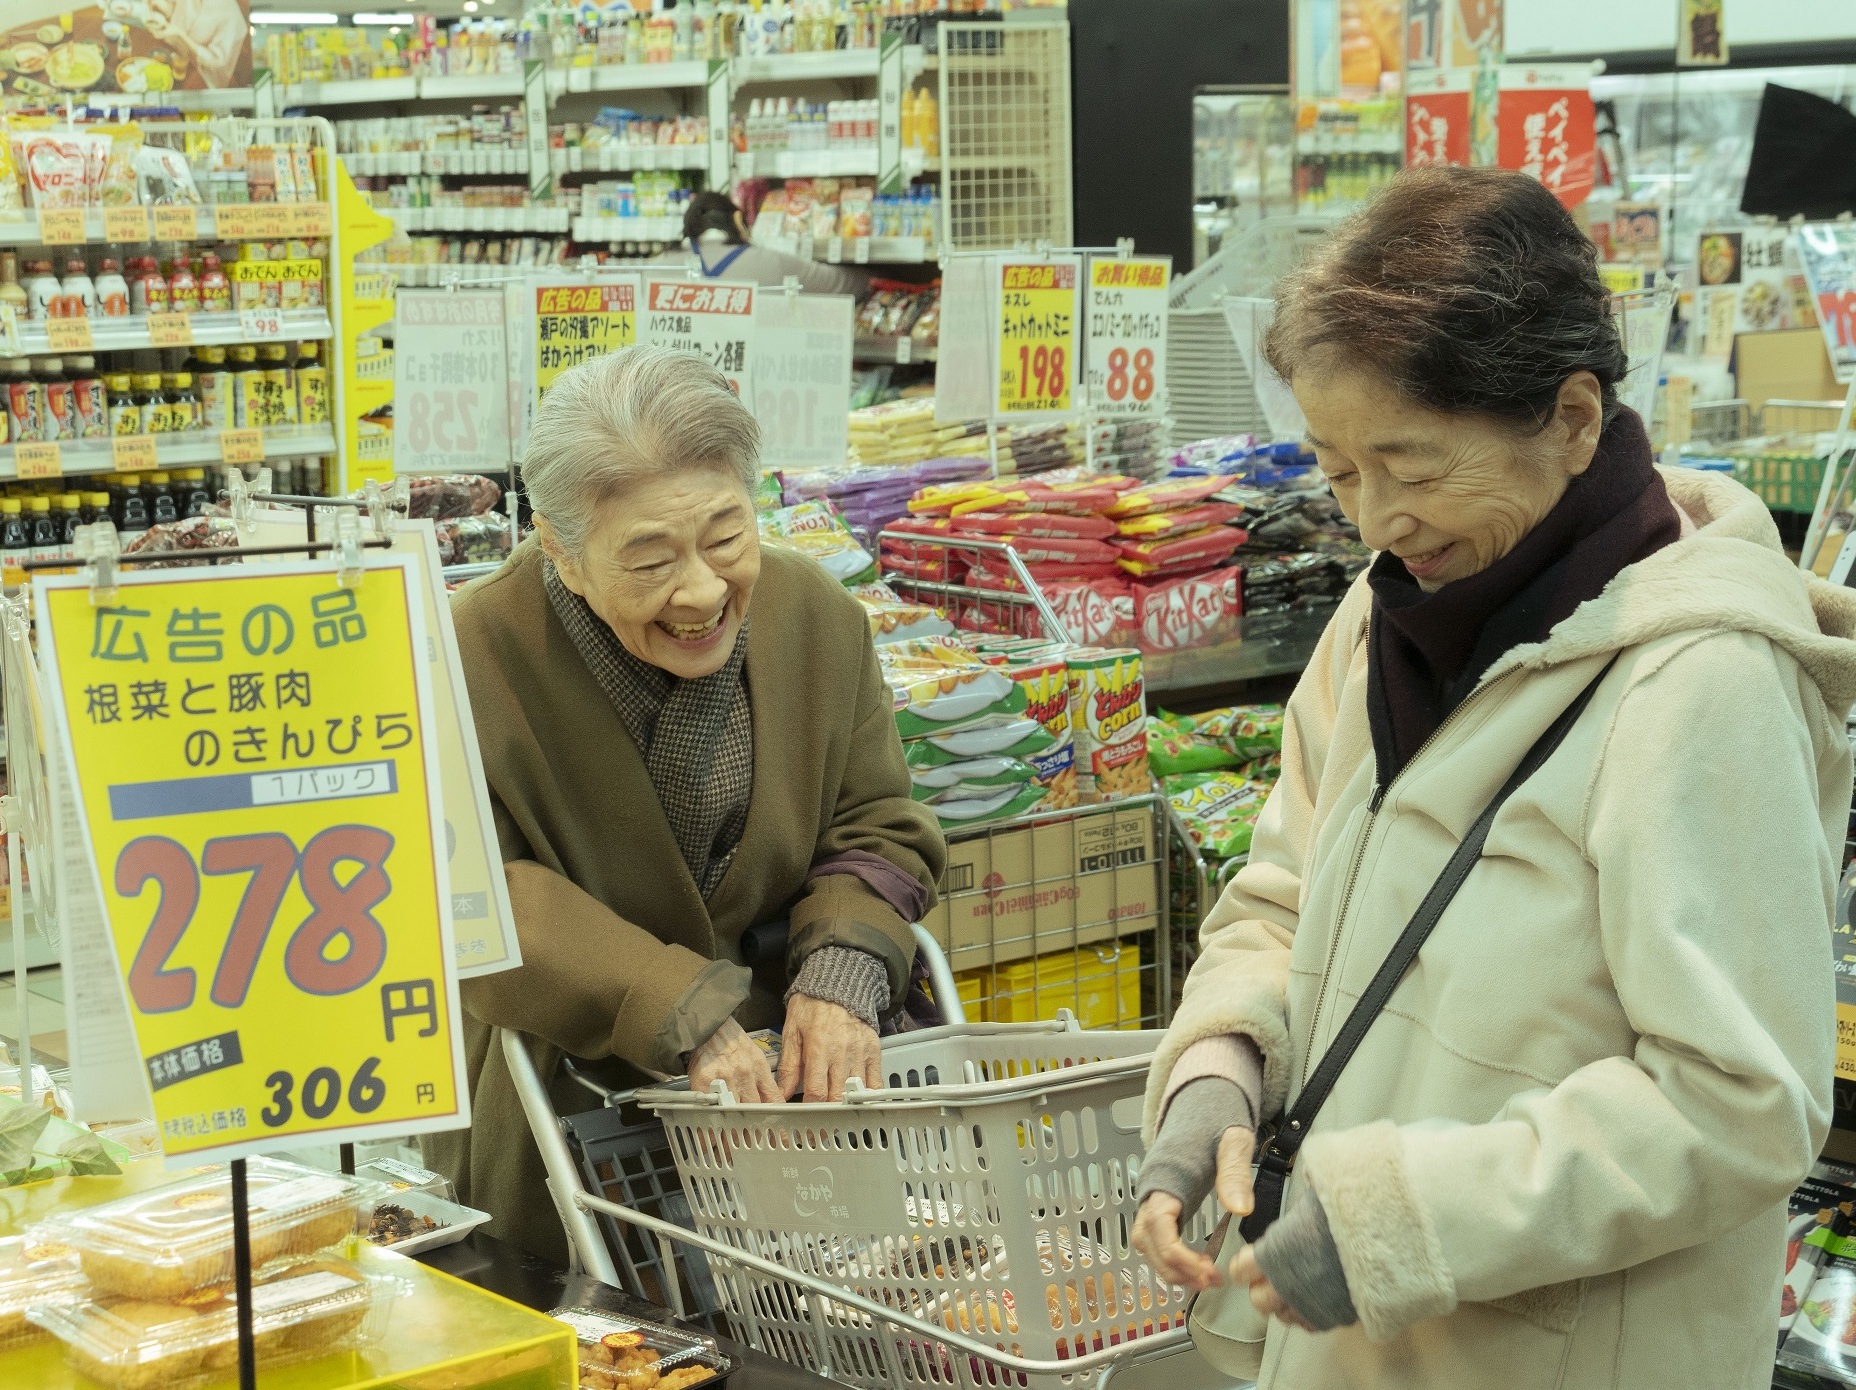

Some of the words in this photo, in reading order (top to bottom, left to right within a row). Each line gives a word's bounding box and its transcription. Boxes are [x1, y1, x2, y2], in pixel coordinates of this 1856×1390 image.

[1547, 97, 1569, 189] ペイペイ
[240, 264, 278, 279] おでん
[282, 262, 320, 279] おでん
[1004, 266, 1056, 288] 広告の品
[539, 287, 602, 312] 広告の品
[655, 285, 749, 314] 更にお買得
[1004, 292, 1031, 307] ネスレ
[1095, 291, 1123, 306] でん六
[255, 319, 279, 334] 98
[650, 315, 692, 333] ハウス食品
[1004, 312, 1070, 339] キットカットミニ
[1019, 344, 1066, 400] 198
[1107, 347, 1155, 402] 88
[90, 588, 368, 665] 広告の品
[1154, 583, 1221, 649] KitKat
[84, 669, 313, 725] 根菜と豚肉
[1094, 680, 1143, 722] とんがり
[1099, 702, 1142, 741] Corn
[184, 712, 414, 768] のきんぴら
[269, 766, 377, 800] 1パック
[114, 824, 396, 1016] 278
[380, 979, 441, 1042] 円
[150, 1039, 224, 1083] 本体価格
[260, 1057, 387, 1129] 306
[416, 1082, 435, 1104] 円
[782, 1166, 800, 1179] 新鮮
[796, 1182, 834, 1203] なかや
[830, 1205, 850, 1219] 市場
